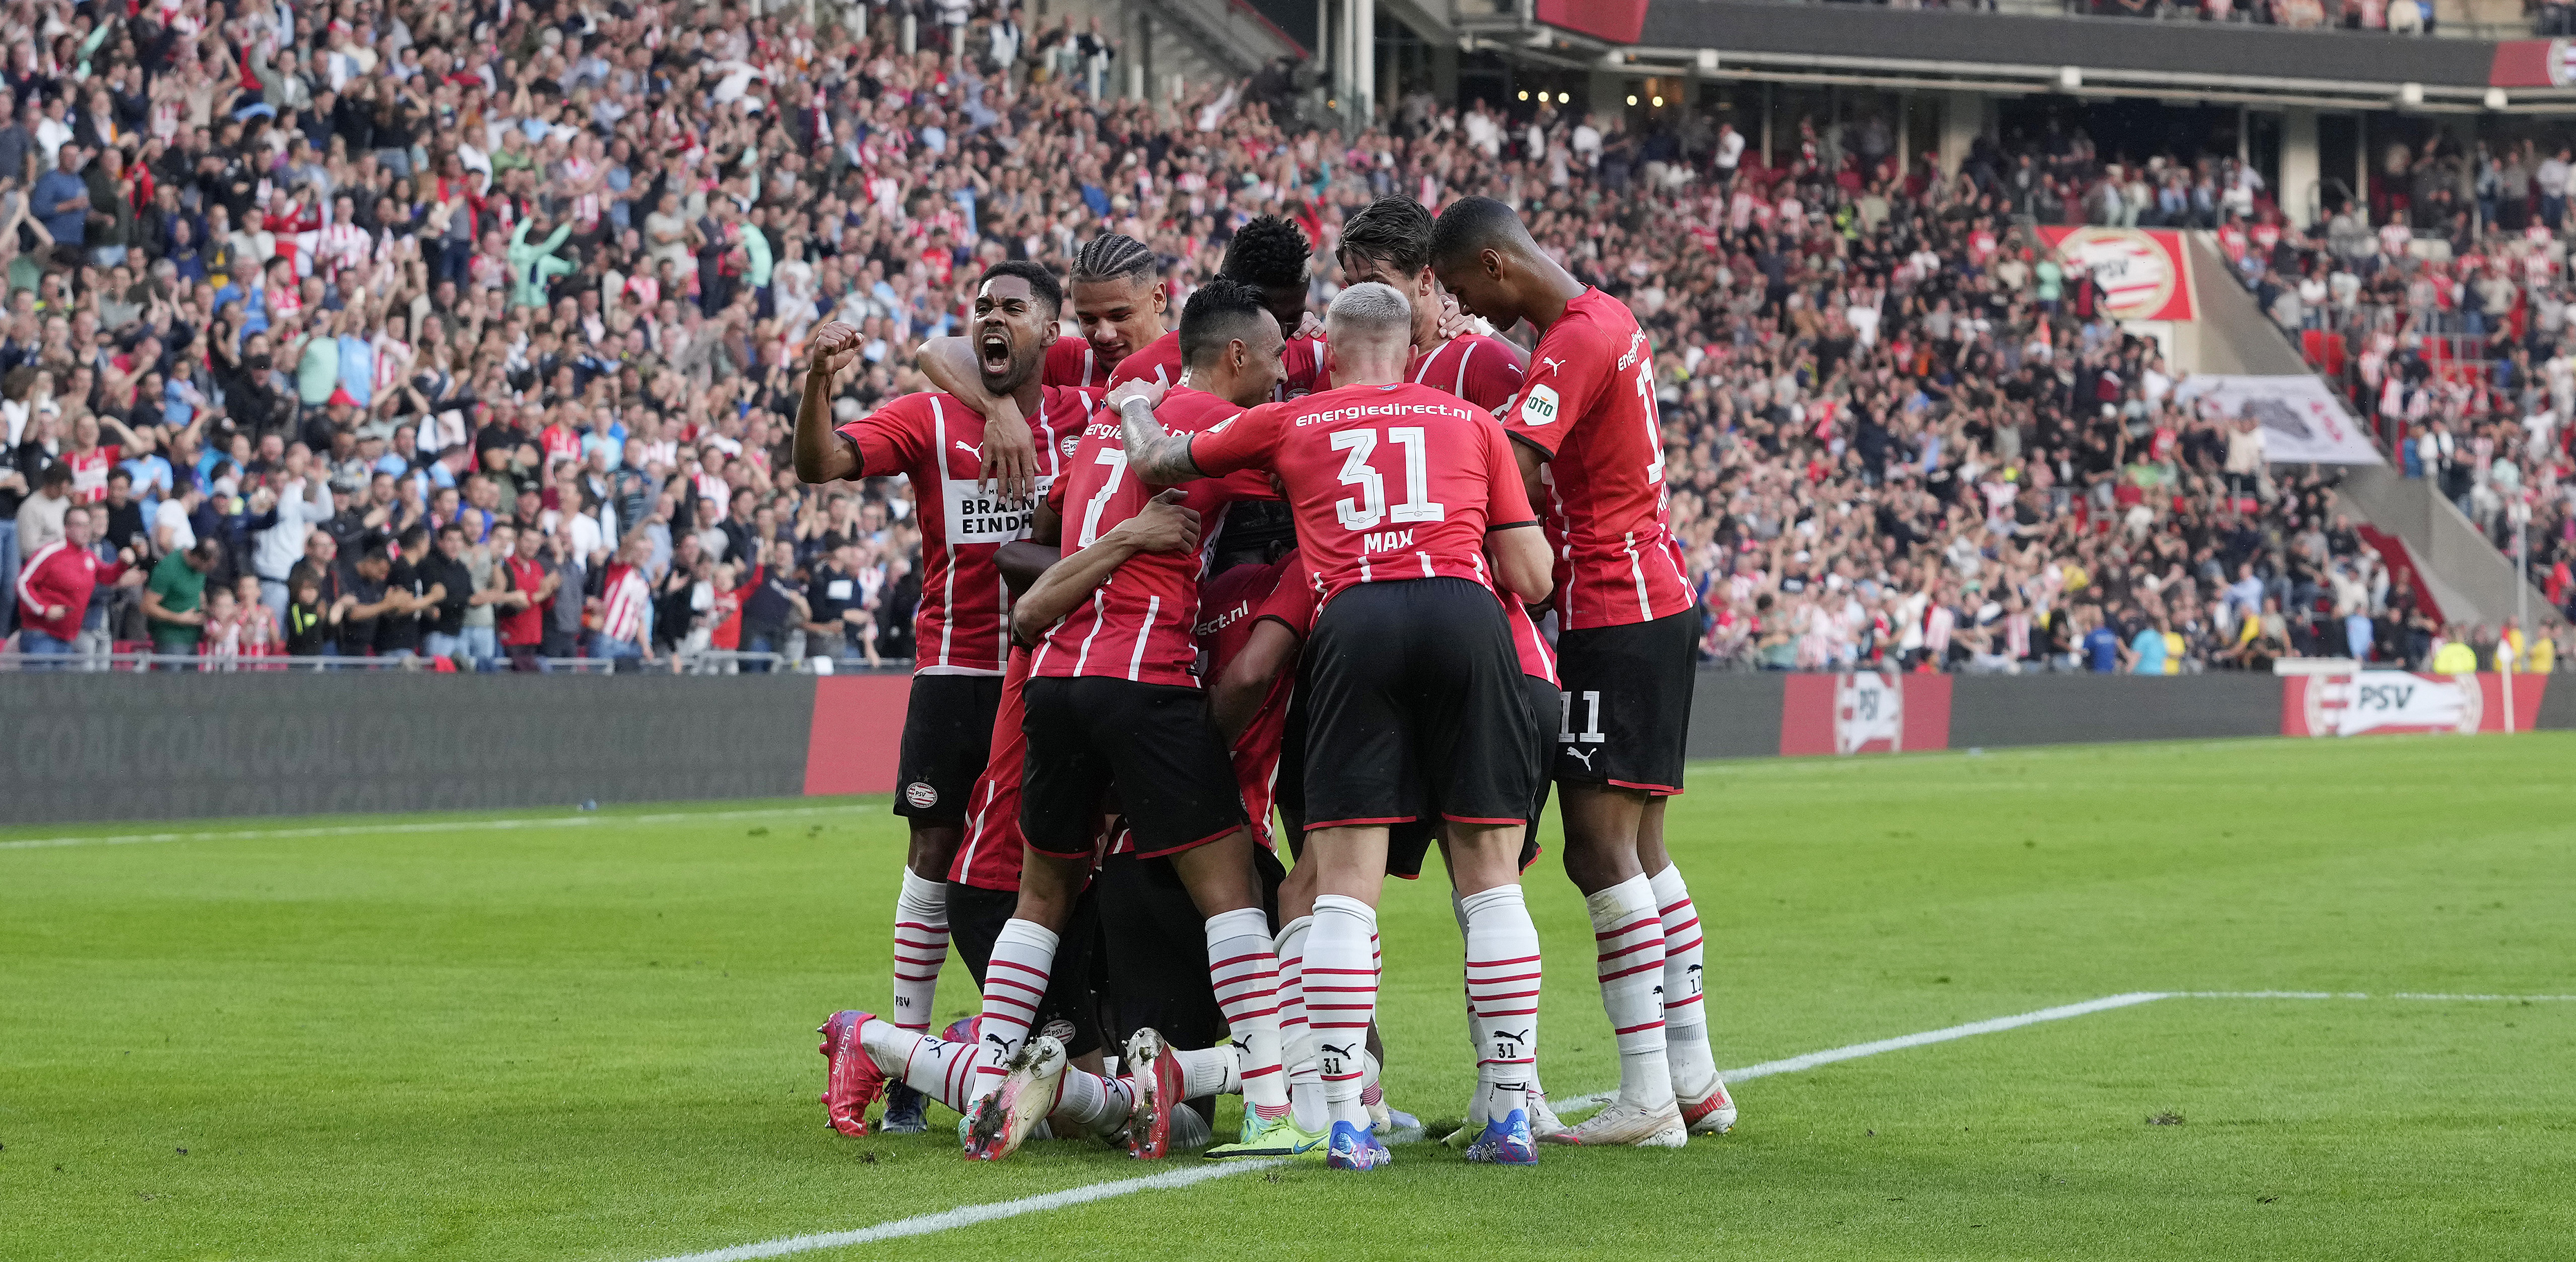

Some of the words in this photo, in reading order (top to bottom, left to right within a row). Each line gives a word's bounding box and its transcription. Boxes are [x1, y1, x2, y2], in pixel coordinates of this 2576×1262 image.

[1296, 403, 1472, 427] energiedirect.nl
[1329, 426, 1445, 531] 31
[1077, 447, 1128, 548] 7
[962, 513, 1033, 534] EINDH
[1364, 528, 1414, 555] MAX
[2358, 684, 2415, 709] PSV
[1559, 690, 1605, 743] 11
[895, 995, 910, 1007] PSV
[1051, 1028, 1064, 1036] PSV
[832, 1025, 854, 1075] ULTRA
[993, 1049, 1002, 1065] 7
[1497, 1043, 1517, 1059] 31
[1323, 1057, 1343, 1075] 31
